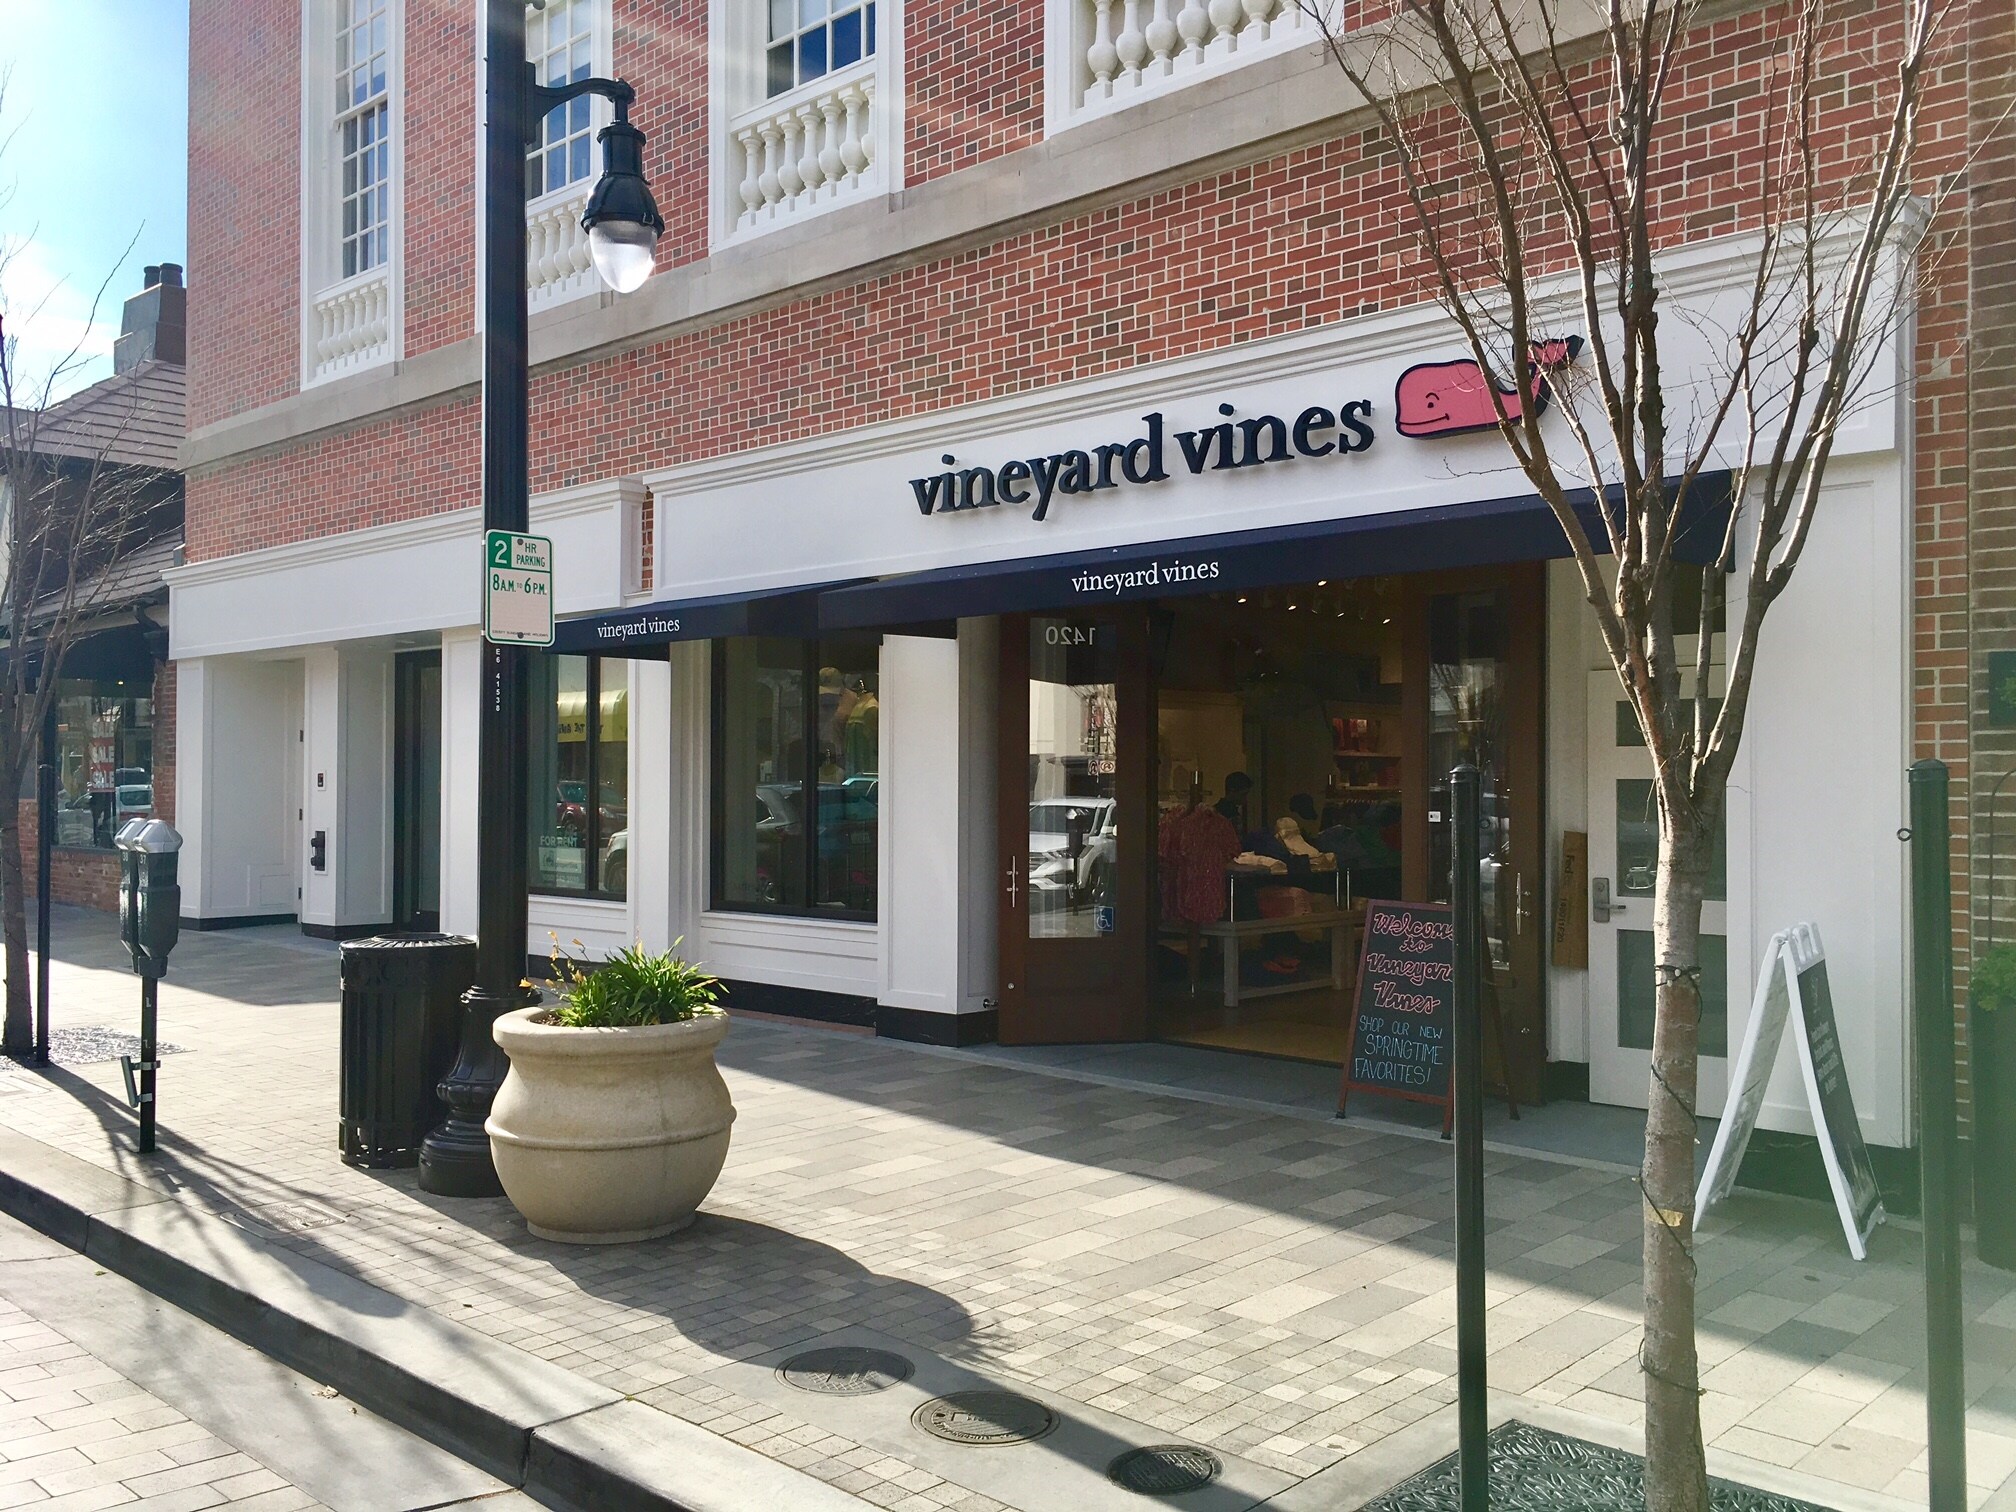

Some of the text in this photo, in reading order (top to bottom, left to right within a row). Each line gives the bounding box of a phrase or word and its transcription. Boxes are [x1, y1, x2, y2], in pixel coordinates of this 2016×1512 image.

[908, 399, 1372, 522] vineyard vines
[494, 539, 537, 564] 2 HR
[516, 554, 545, 567] PARKING
[1071, 559, 1220, 595] vineyard vines
[597, 616, 680, 641] vineyard vines
[540, 835, 555, 846] FOR
[1399, 936, 1433, 953] to
[1367, 953, 1453, 986] Vineyar
[1373, 980, 1440, 1014] Vines
[1359, 1015, 1443, 1039] SHOP OUR NEW
[1364, 1033, 1443, 1065] SPRINGTIME
[1355, 1057, 1431, 1084] FAVORITES!
